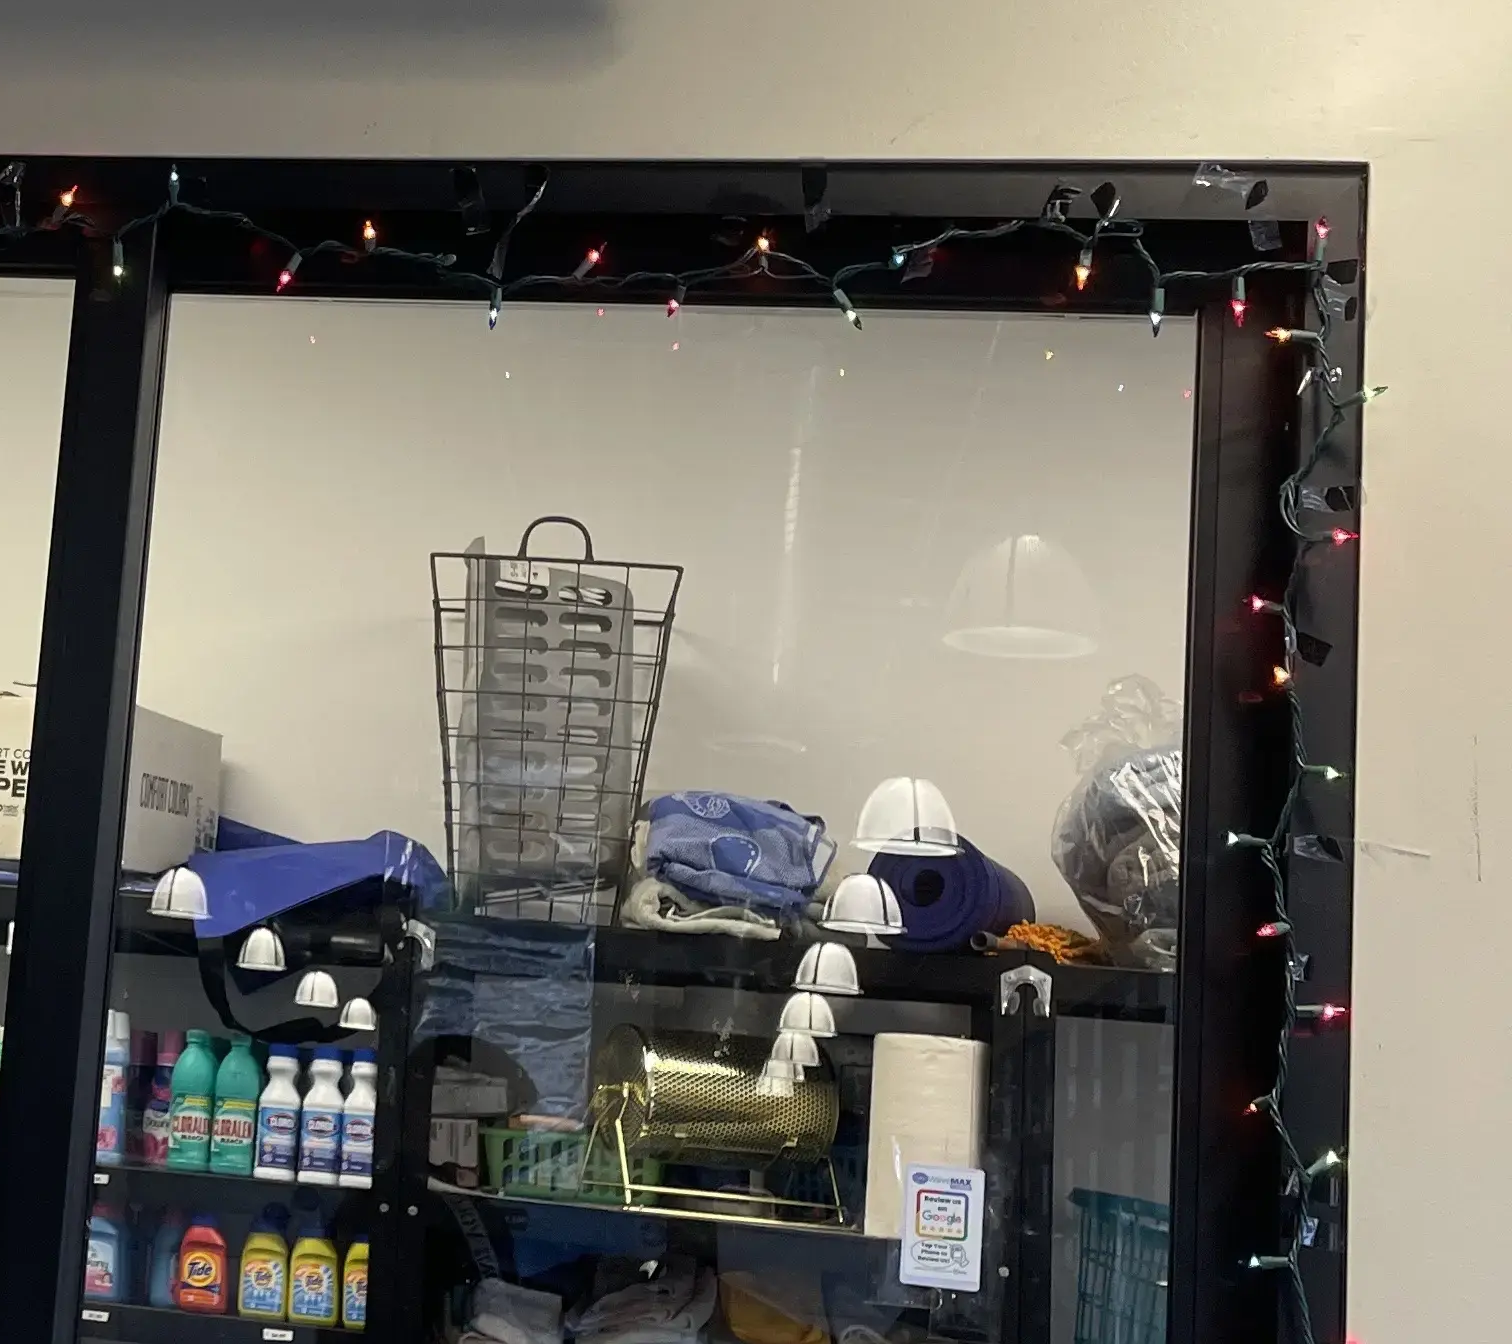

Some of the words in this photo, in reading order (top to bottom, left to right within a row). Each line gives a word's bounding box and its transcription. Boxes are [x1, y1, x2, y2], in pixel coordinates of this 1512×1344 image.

[924, 1195, 951, 1204] Review
[922, 1210, 962, 1225] Google
[187, 1261, 213, 1279] Tide
[254, 1271, 273, 1283] Tide
[305, 1275, 324, 1287] Tide
